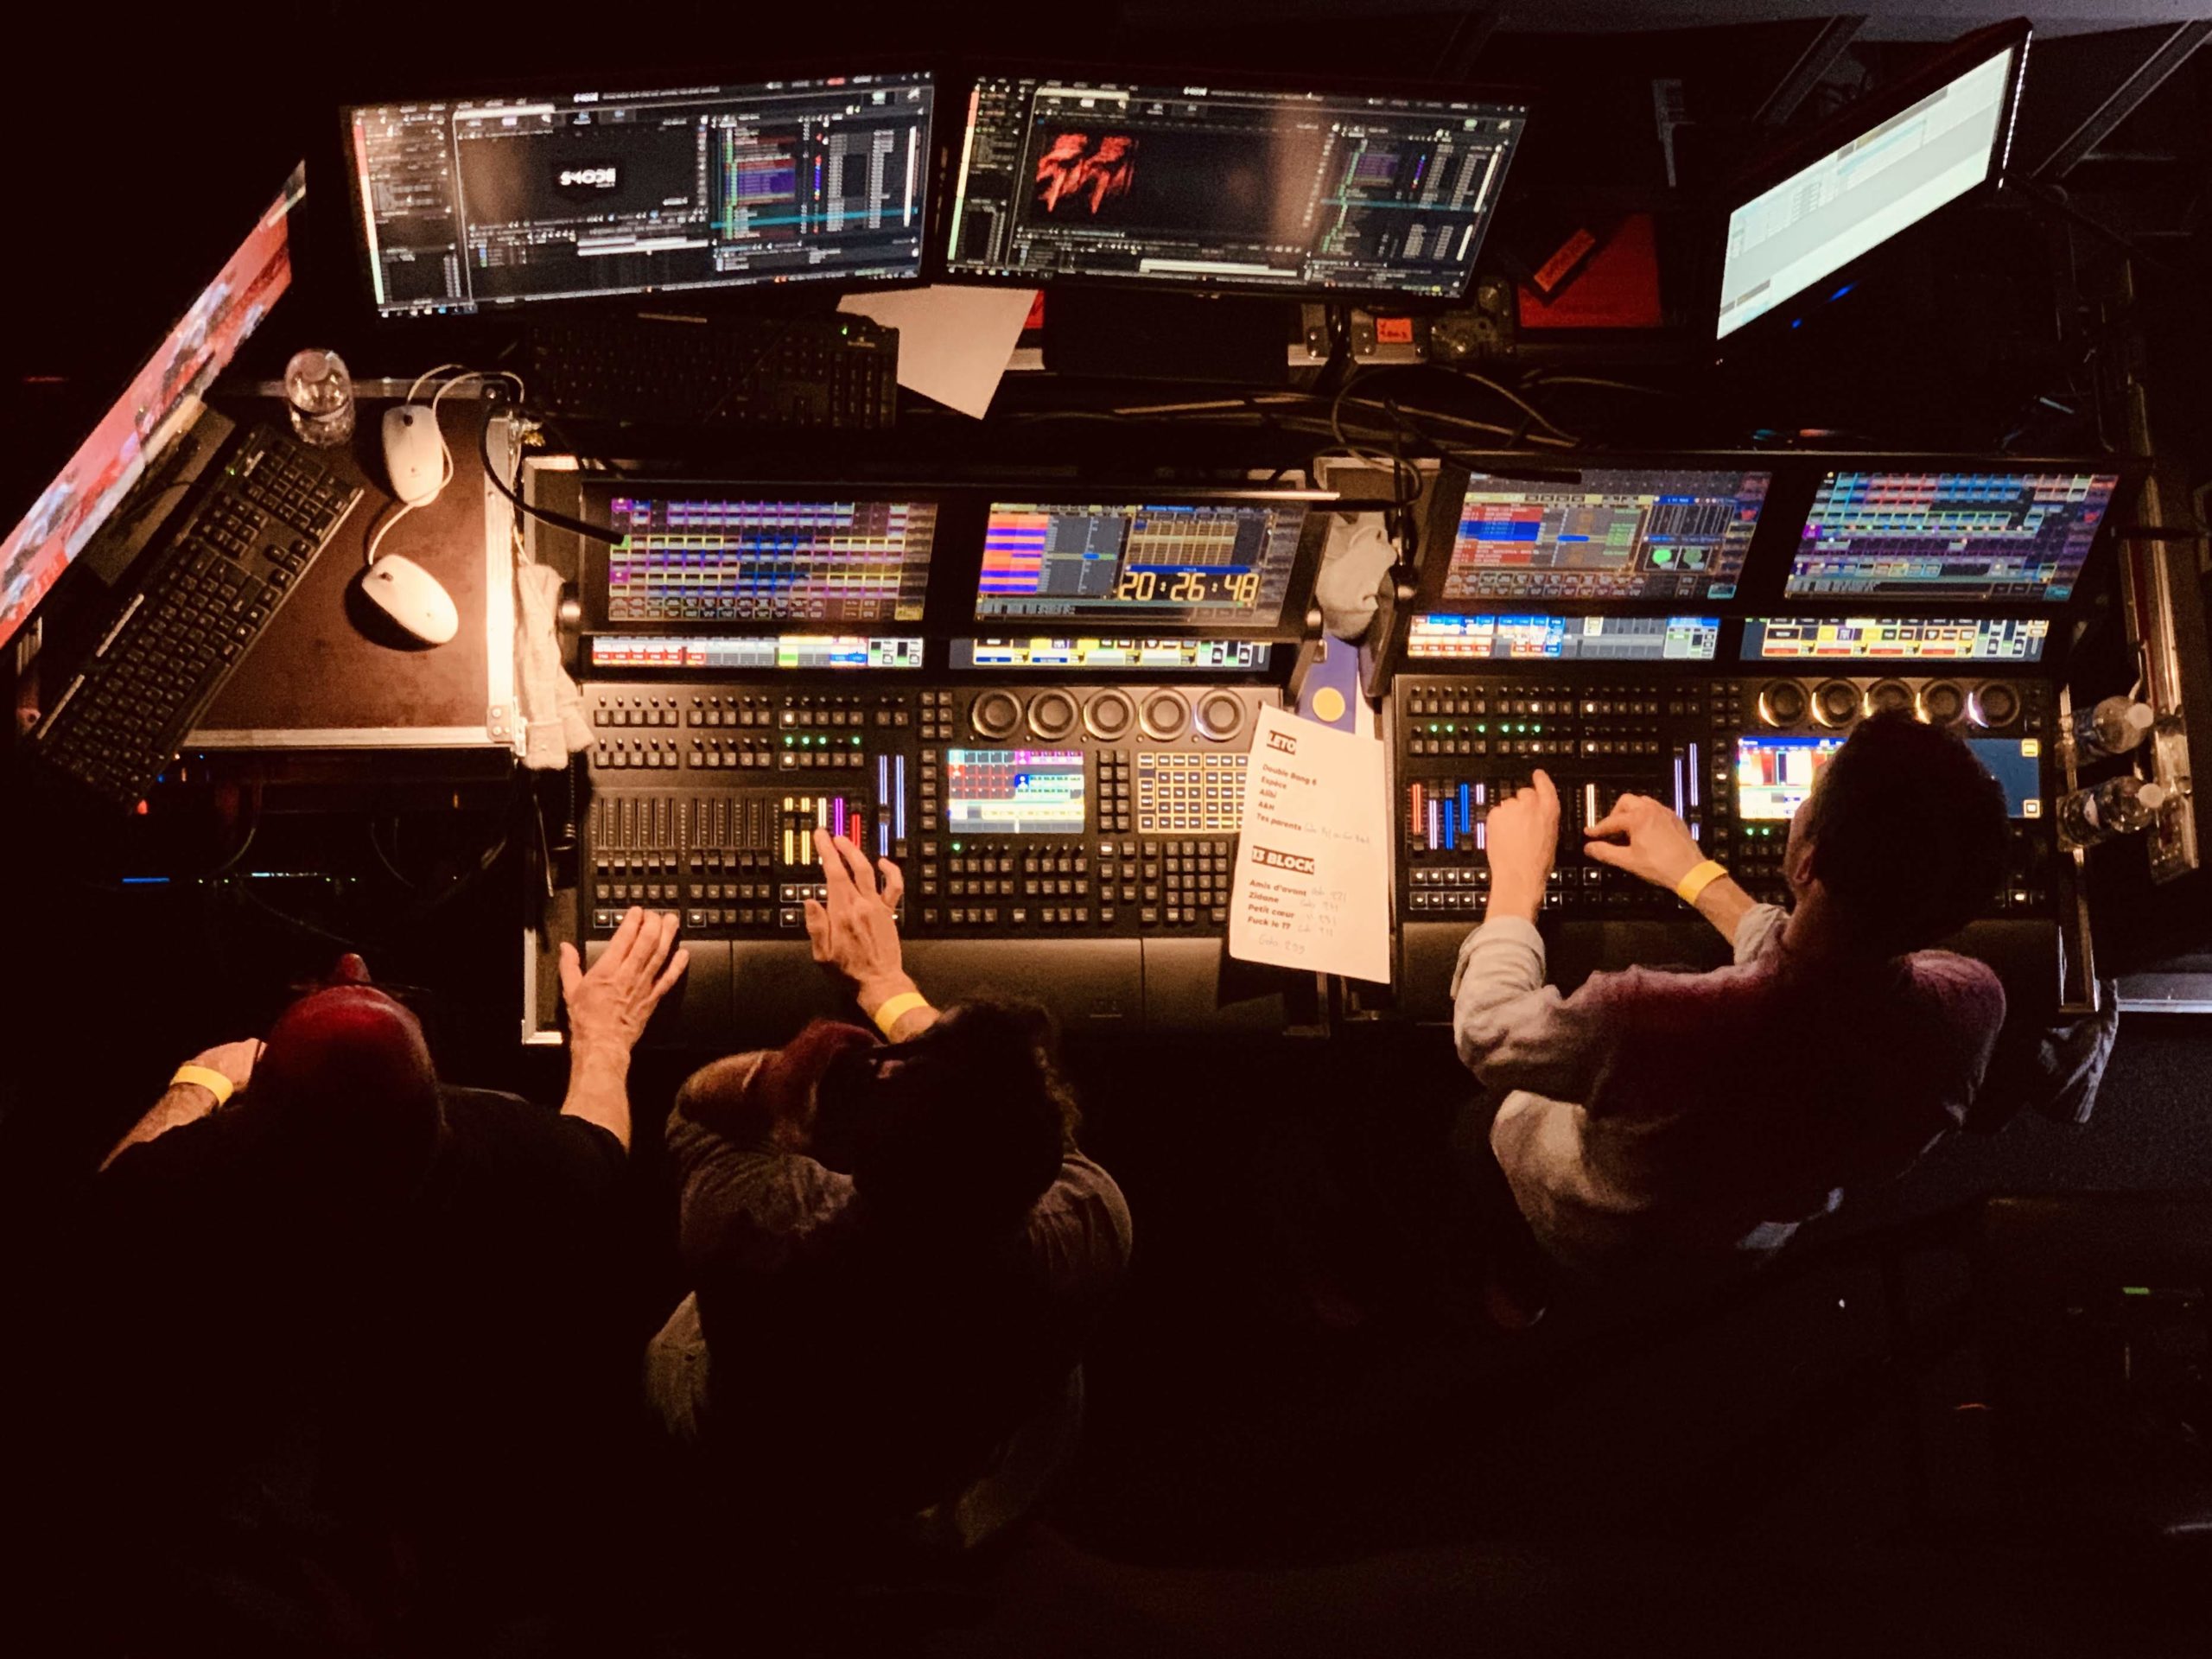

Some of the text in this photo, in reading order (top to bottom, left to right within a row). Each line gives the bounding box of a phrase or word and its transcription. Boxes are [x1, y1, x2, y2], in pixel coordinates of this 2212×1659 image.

[1268, 732, 1296, 753] LETO
[1262, 764, 1288, 777] Double
[1257, 813, 1302, 830] Tes parents
[1253, 849, 1314, 872] 13 BLOCK
[1249, 880, 1306, 896] Amis d'avant
[1249, 892, 1279, 902] Zidane
[1249, 904, 1269, 913] Petit
[1247, 916, 1268, 926] Fuck
